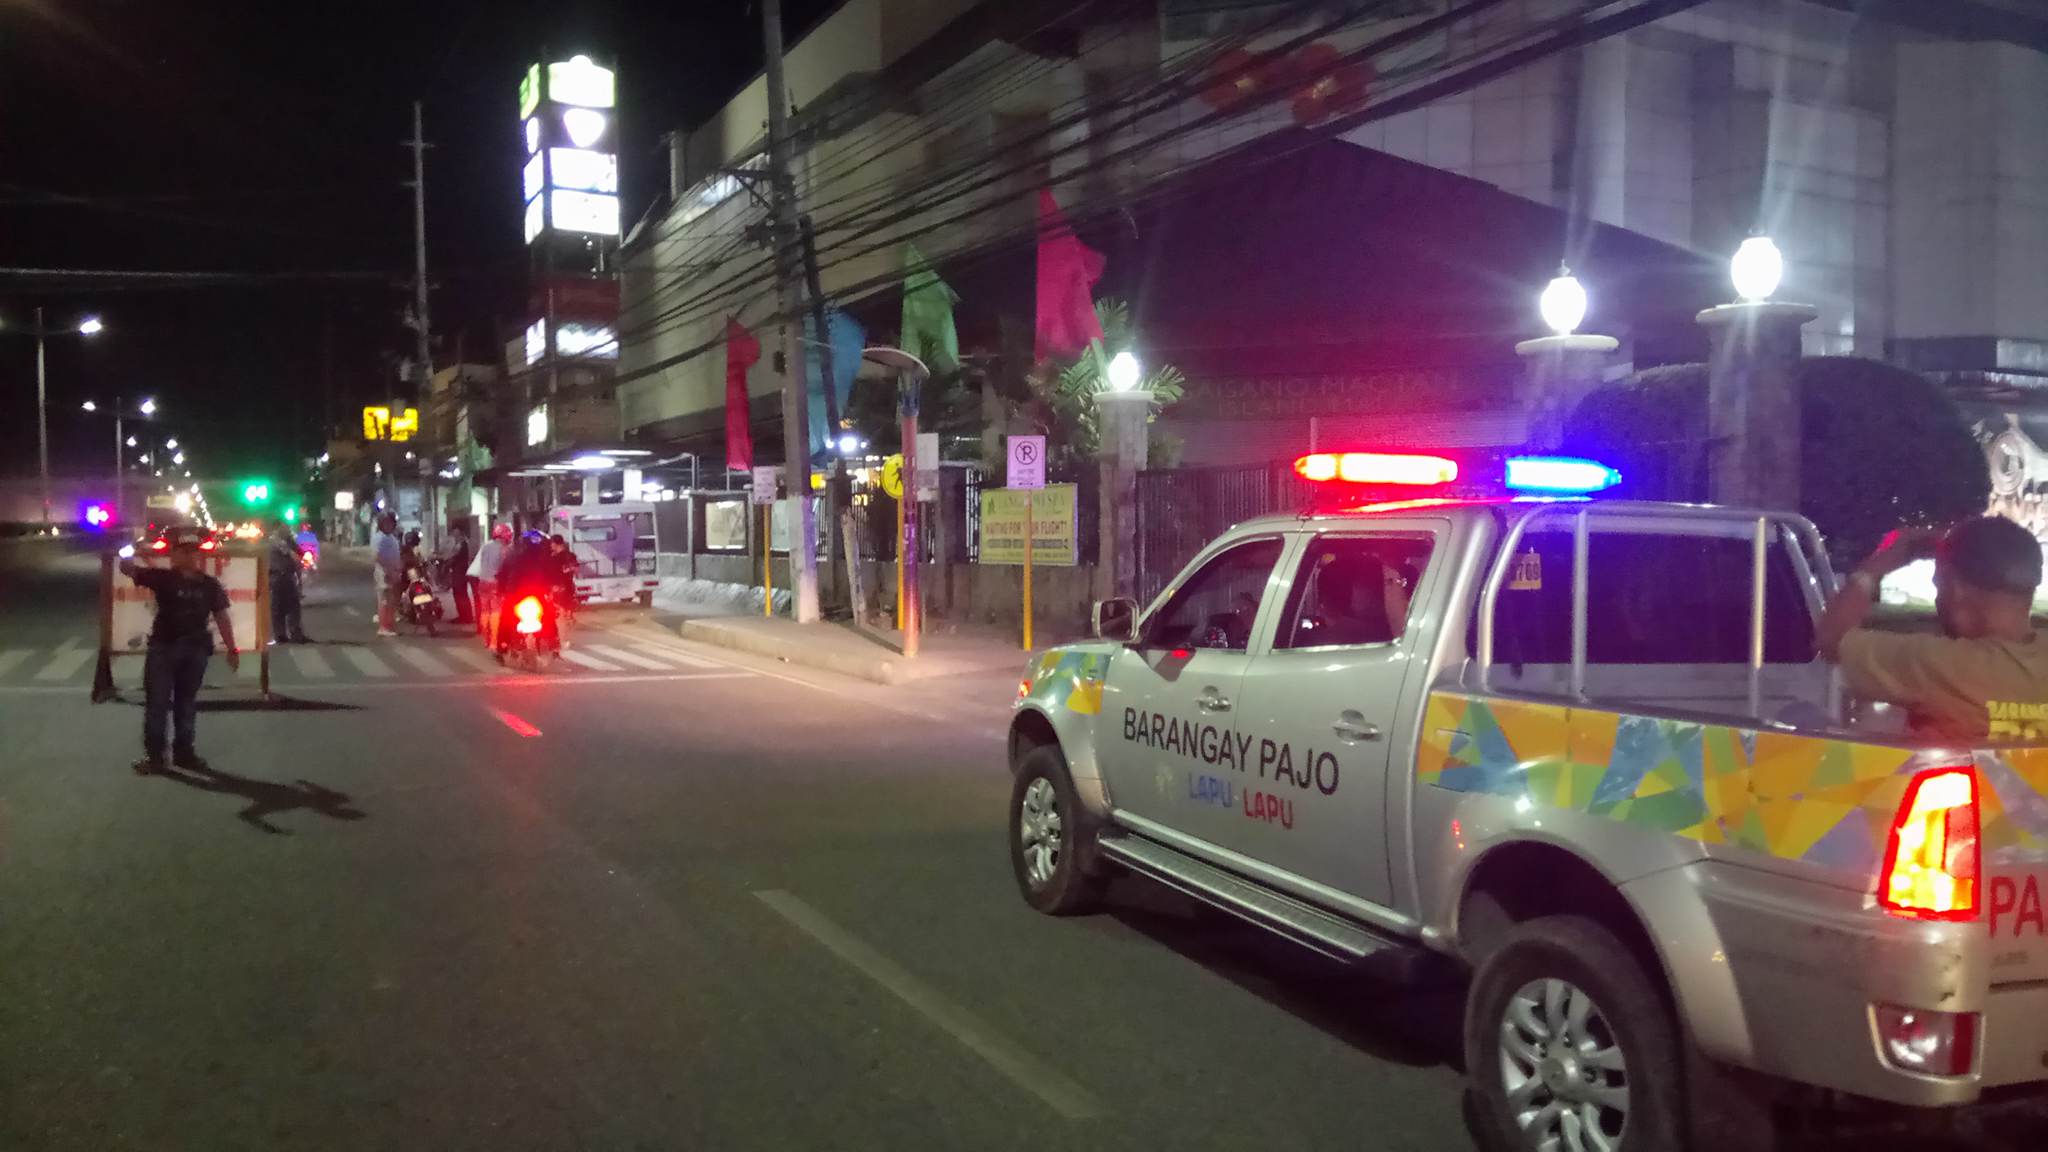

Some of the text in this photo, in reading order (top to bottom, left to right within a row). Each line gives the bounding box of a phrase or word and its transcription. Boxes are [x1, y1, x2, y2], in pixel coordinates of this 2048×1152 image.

[1124, 707, 1340, 796] BARANGAY PAJO
[1189, 773, 1293, 830] LAPU LAPU
